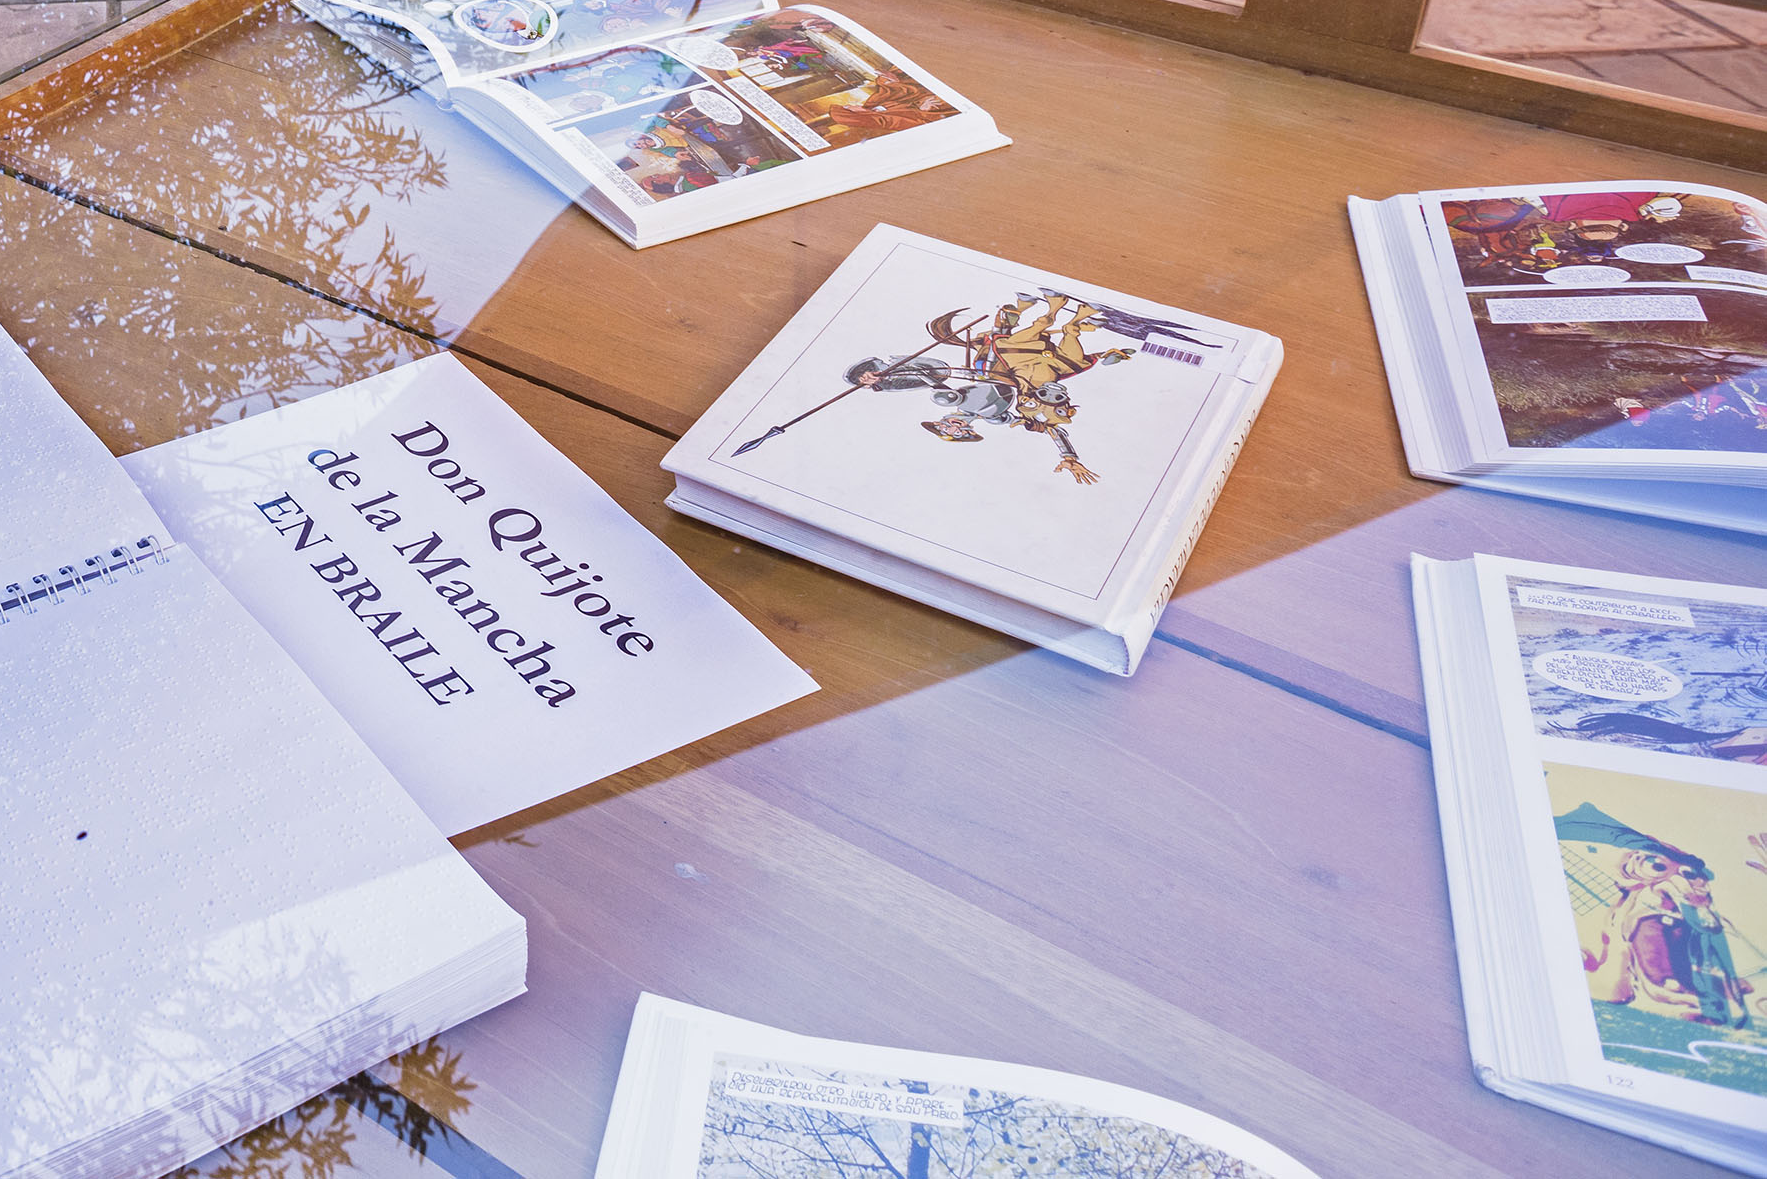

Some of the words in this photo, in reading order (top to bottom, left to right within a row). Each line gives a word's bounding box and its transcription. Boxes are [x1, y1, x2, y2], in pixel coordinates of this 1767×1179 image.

[254, 492, 332, 552] EN
[310, 552, 474, 708] BRAILE
[307, 448, 361, 491] de
[352, 490, 402, 533] la
[393, 531, 577, 709] Mancha
[391, 421, 486, 505] Don
[488, 507, 655, 658] Quijote
[732, 1071, 812, 1091] DESCUBRIERON
[816, 1085, 844, 1096] OTRO
[895, 1095, 902, 1103] Y
[750, 1084, 775, 1095] UNA
[879, 1101, 891, 1111] DE
[895, 1104, 921, 1115] SAN
[1606, 1074, 1634, 1090] 122
